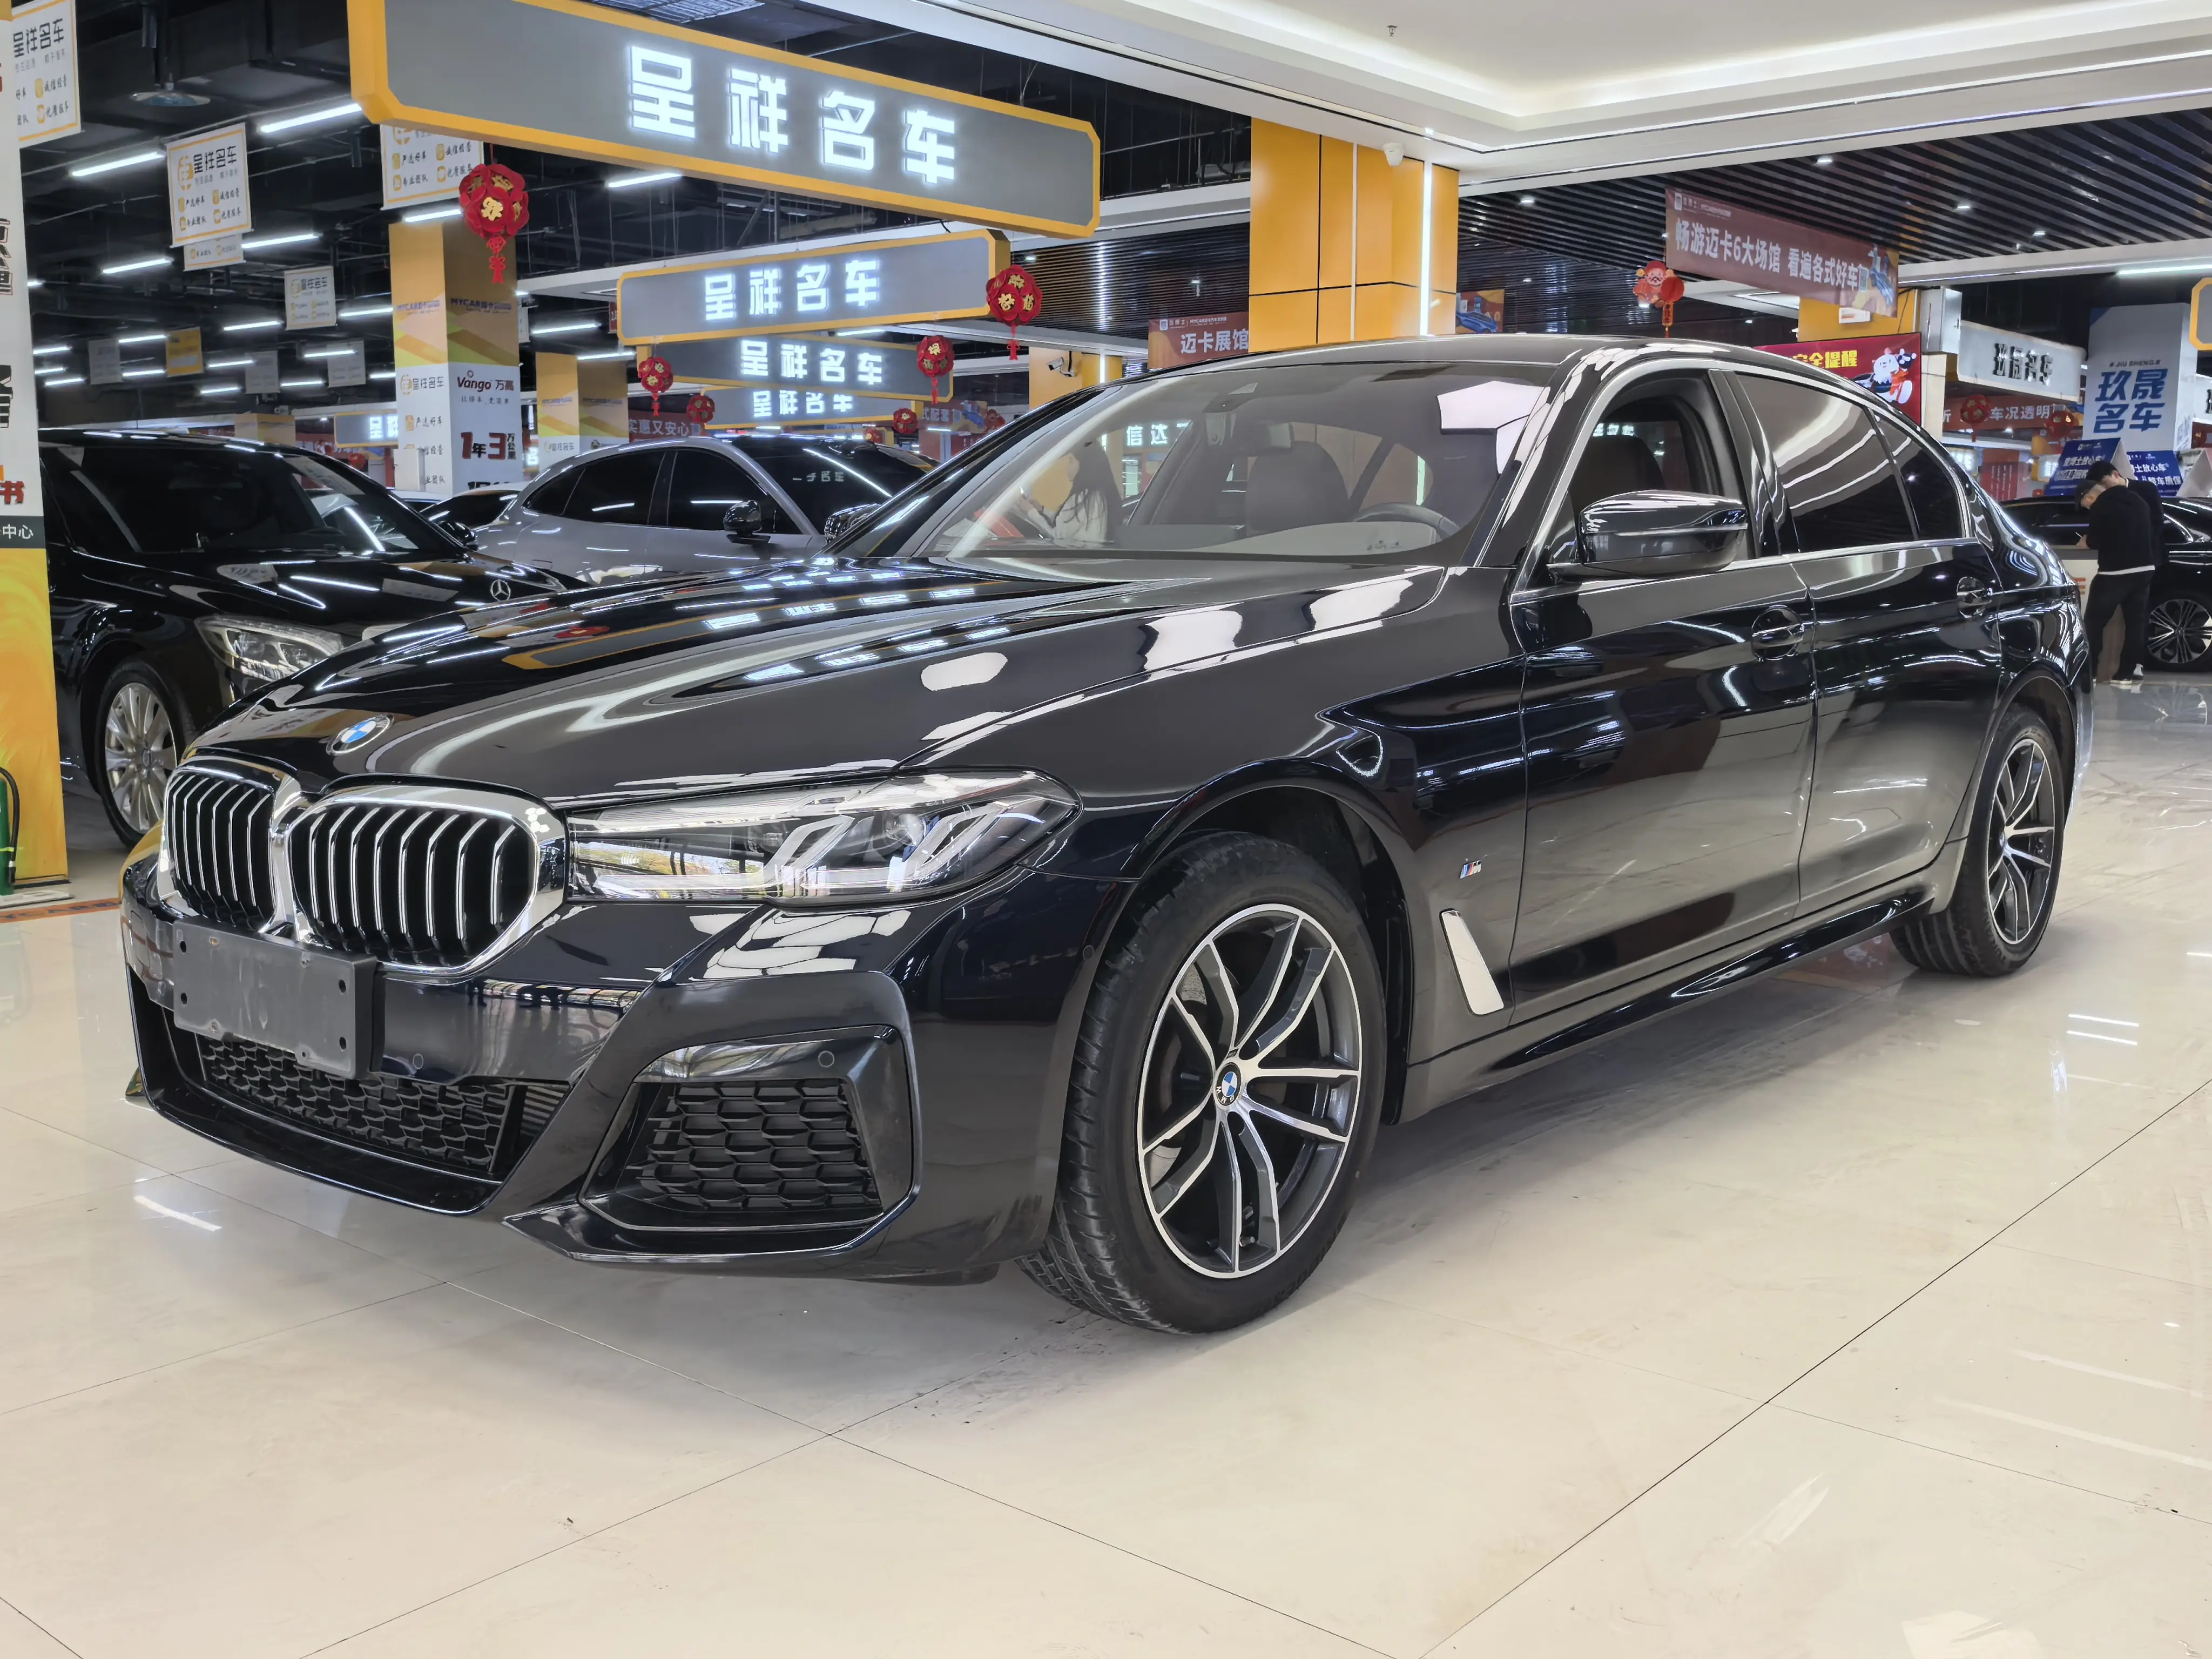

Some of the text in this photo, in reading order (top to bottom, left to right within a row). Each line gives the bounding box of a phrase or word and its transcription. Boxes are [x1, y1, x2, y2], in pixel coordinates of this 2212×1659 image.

[13, 18, 64, 58] 呈祥名车
[628, 45, 955, 184] 呈祥名车
[193, 146, 237, 174] 呈祥名车
[1676, 218, 1858, 291] 畅游迈卡6大场馆 看遍各式好车
[704, 260, 878, 321] 呈祥名车
[1181, 328, 1249, 354] 迈卡展馆
[740, 339, 882, 385] 呈祥名车
[457, 376, 491, 392] Vango
[2095, 368, 2168, 401] 玖晟
[1990, 404, 2050, 420] 车况透明
[2093, 402, 2166, 433] 名车
[1127, 423, 1191, 446] 信达
[2, 523, 33, 539] 中心
